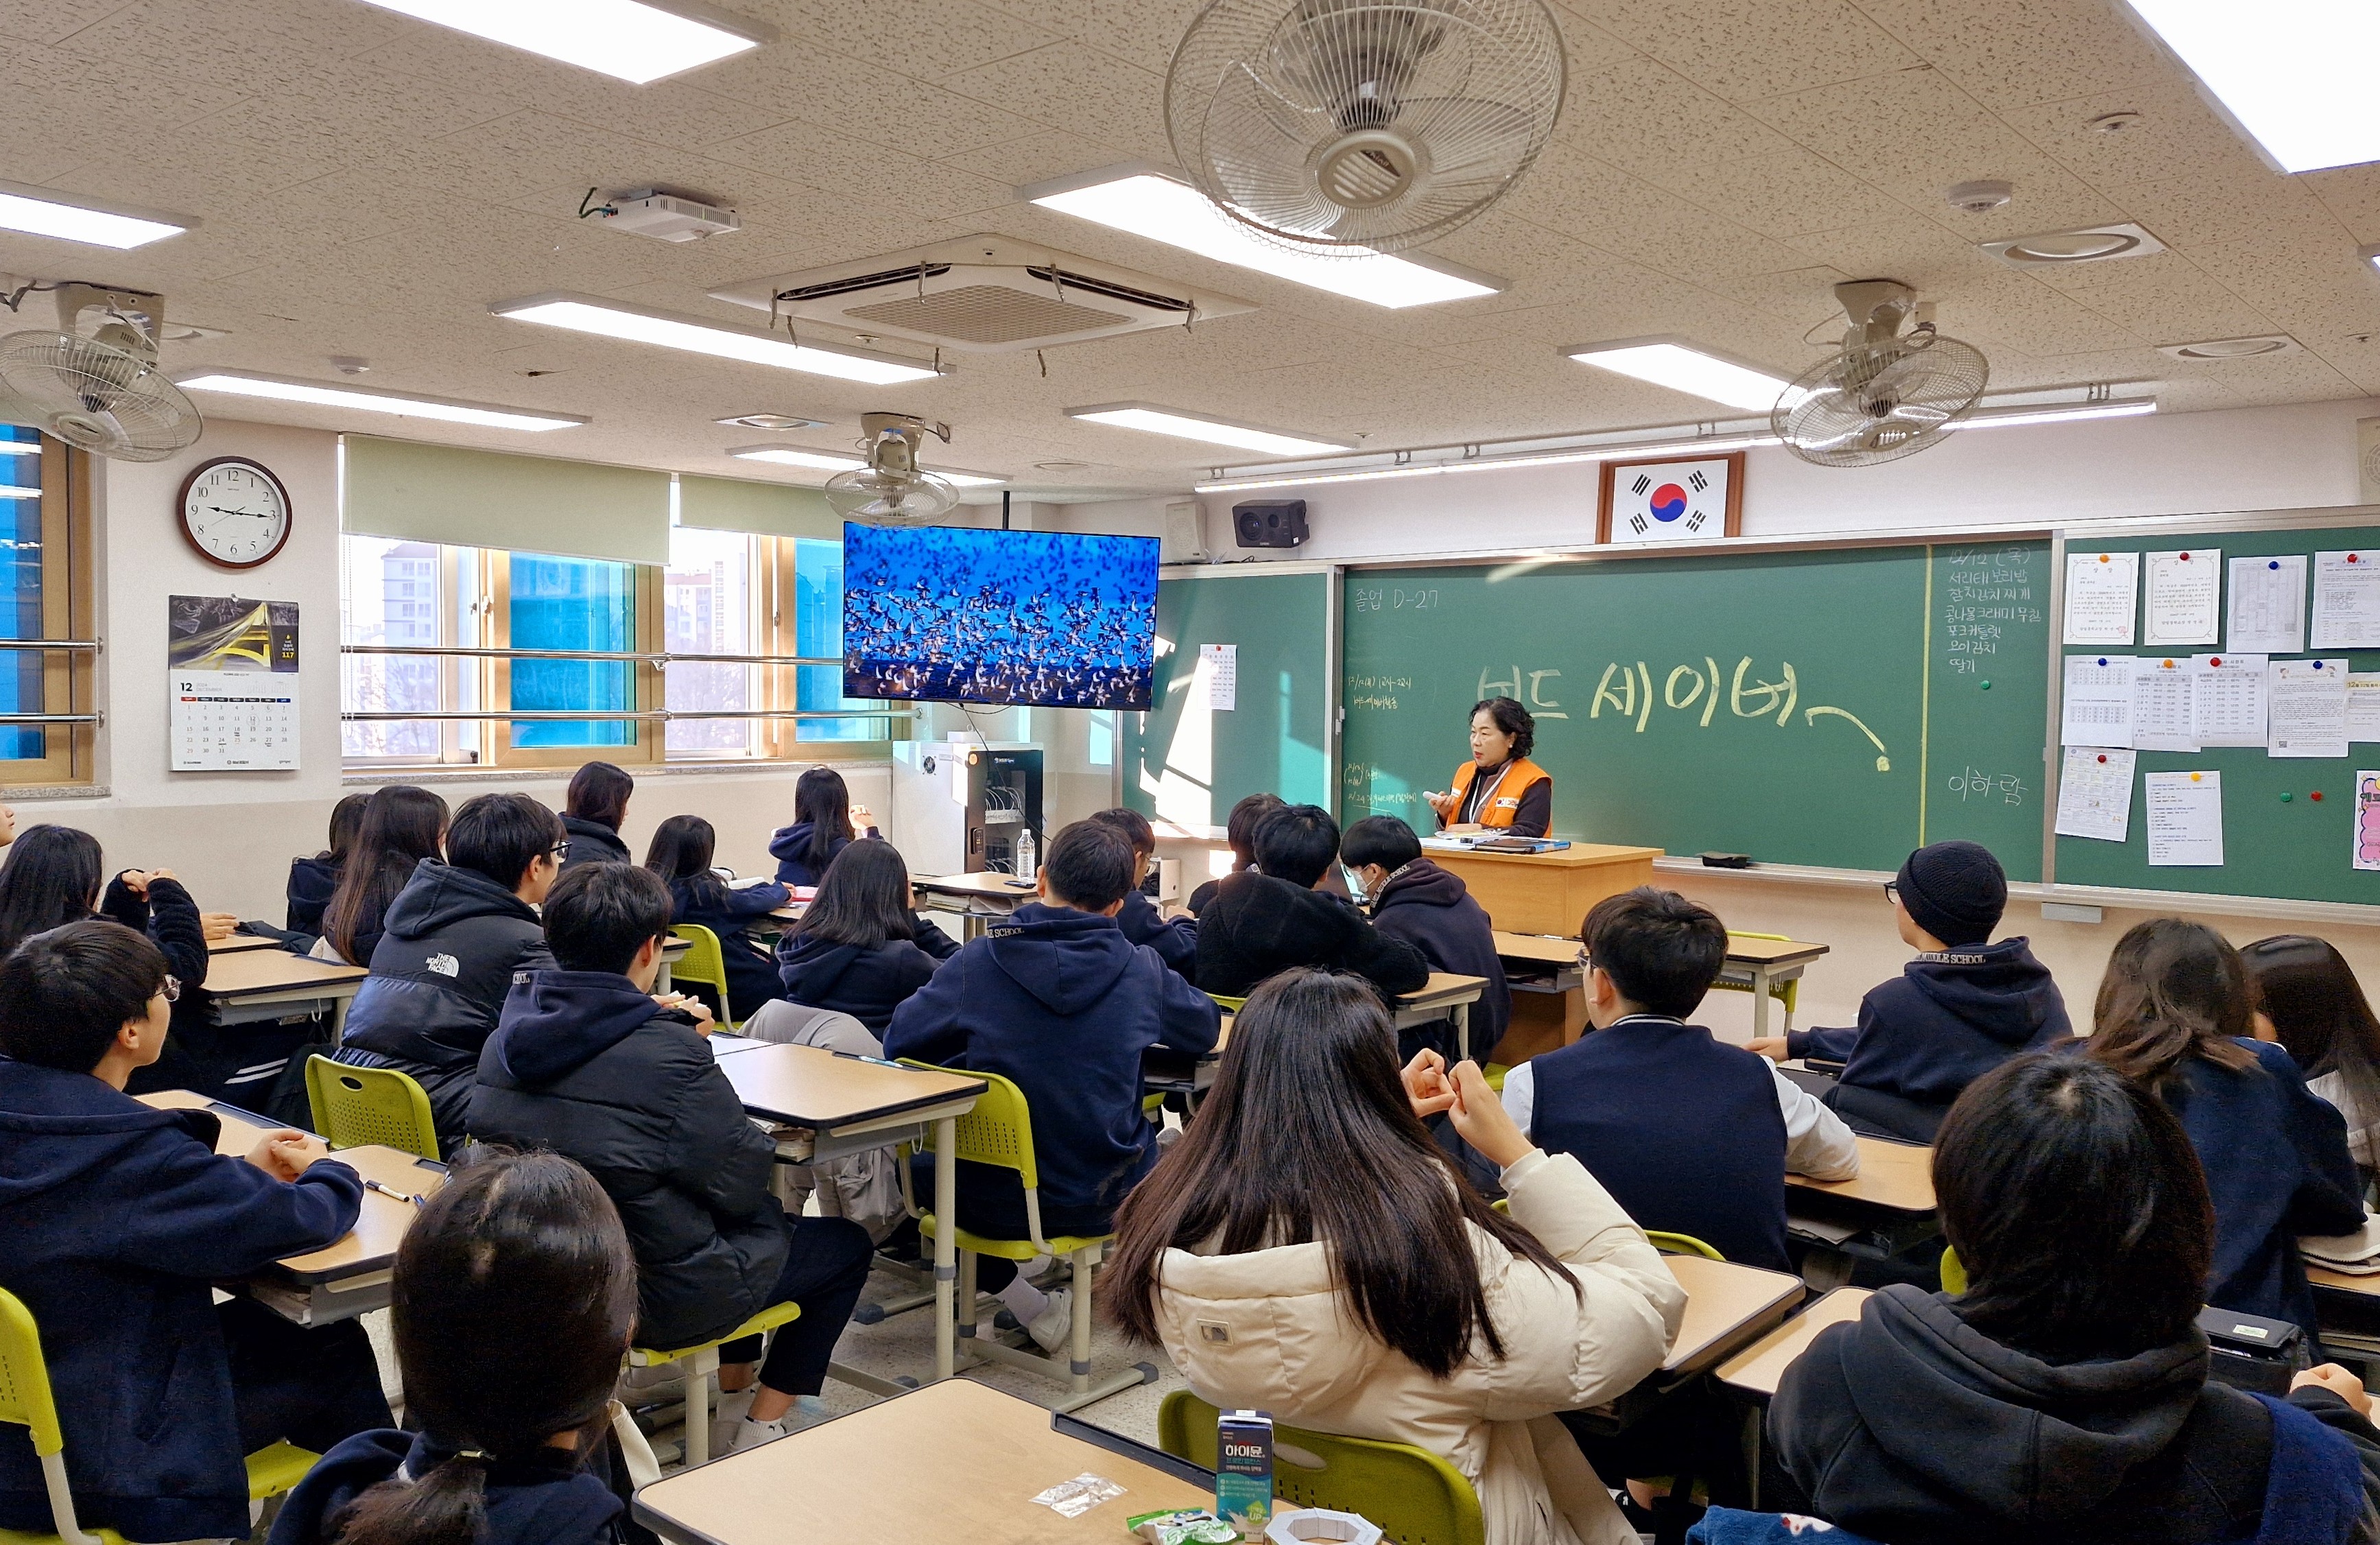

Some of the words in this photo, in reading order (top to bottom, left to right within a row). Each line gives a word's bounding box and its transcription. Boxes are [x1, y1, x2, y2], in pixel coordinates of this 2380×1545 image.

[211, 475, 219, 485] 11
[228, 471, 239, 482] 12
[250, 477, 254, 488] 1
[198, 486, 209, 497] 10
[262, 491, 270, 502] 2
[191, 504, 198, 515] 9
[269, 510, 276, 520] 3
[198, 524, 204, 534] 8
[263, 528, 270, 539] 4
[212, 539, 219, 549] 7
[230, 543, 237, 554] 6
[250, 541, 257, 551] 5
[1949, 549, 1987, 565] 12/12
[1996, 547, 2030, 567] (목)
[1949, 571, 1988, 585] 서리태
[1992, 569, 2027, 583] 보리밥
[1355, 588, 1382, 612] 졸업
[1394, 589, 1438, 609] D-27
[2018, 606, 2042, 623] 무침
[1949, 658, 1975, 674] 딸기
[180, 682, 193, 692] 12
[1477, 664, 1569, 719] 버드
[1591, 656, 1797, 733] 세이버
[1949, 766, 2029, 806] 이하람
[995, 927, 1025, 939] SCHOOL
[425, 956, 447, 967] NORTH
[437, 952, 451, 962] THE
[1950, 954, 1986, 965] SCHOOL
[428, 965, 446, 974] FACE
[1249, 1512, 1263, 1522] UP
